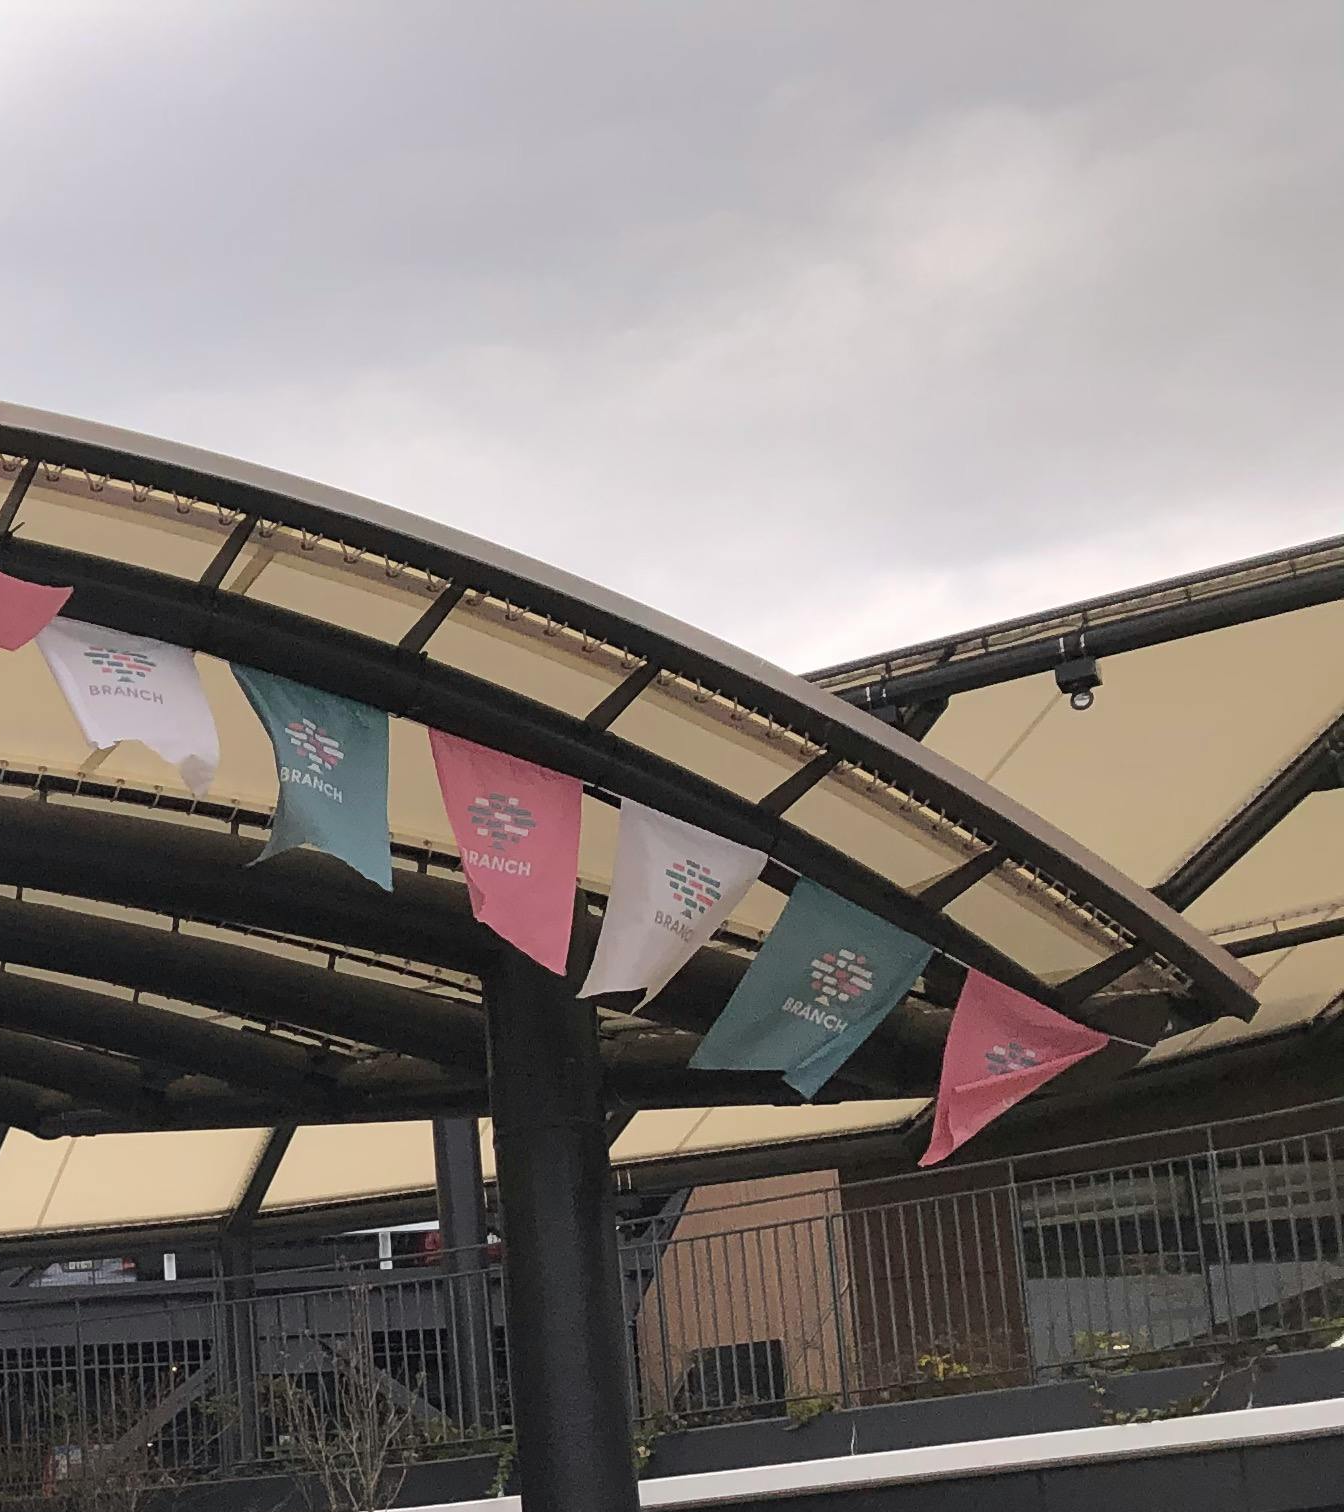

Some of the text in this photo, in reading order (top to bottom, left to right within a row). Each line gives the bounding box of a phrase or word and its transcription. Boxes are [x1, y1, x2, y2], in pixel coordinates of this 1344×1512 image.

[88, 684, 165, 705] BRANCH
[279, 766, 344, 804] BRANCH
[781, 996, 849, 1034] BRANCH
